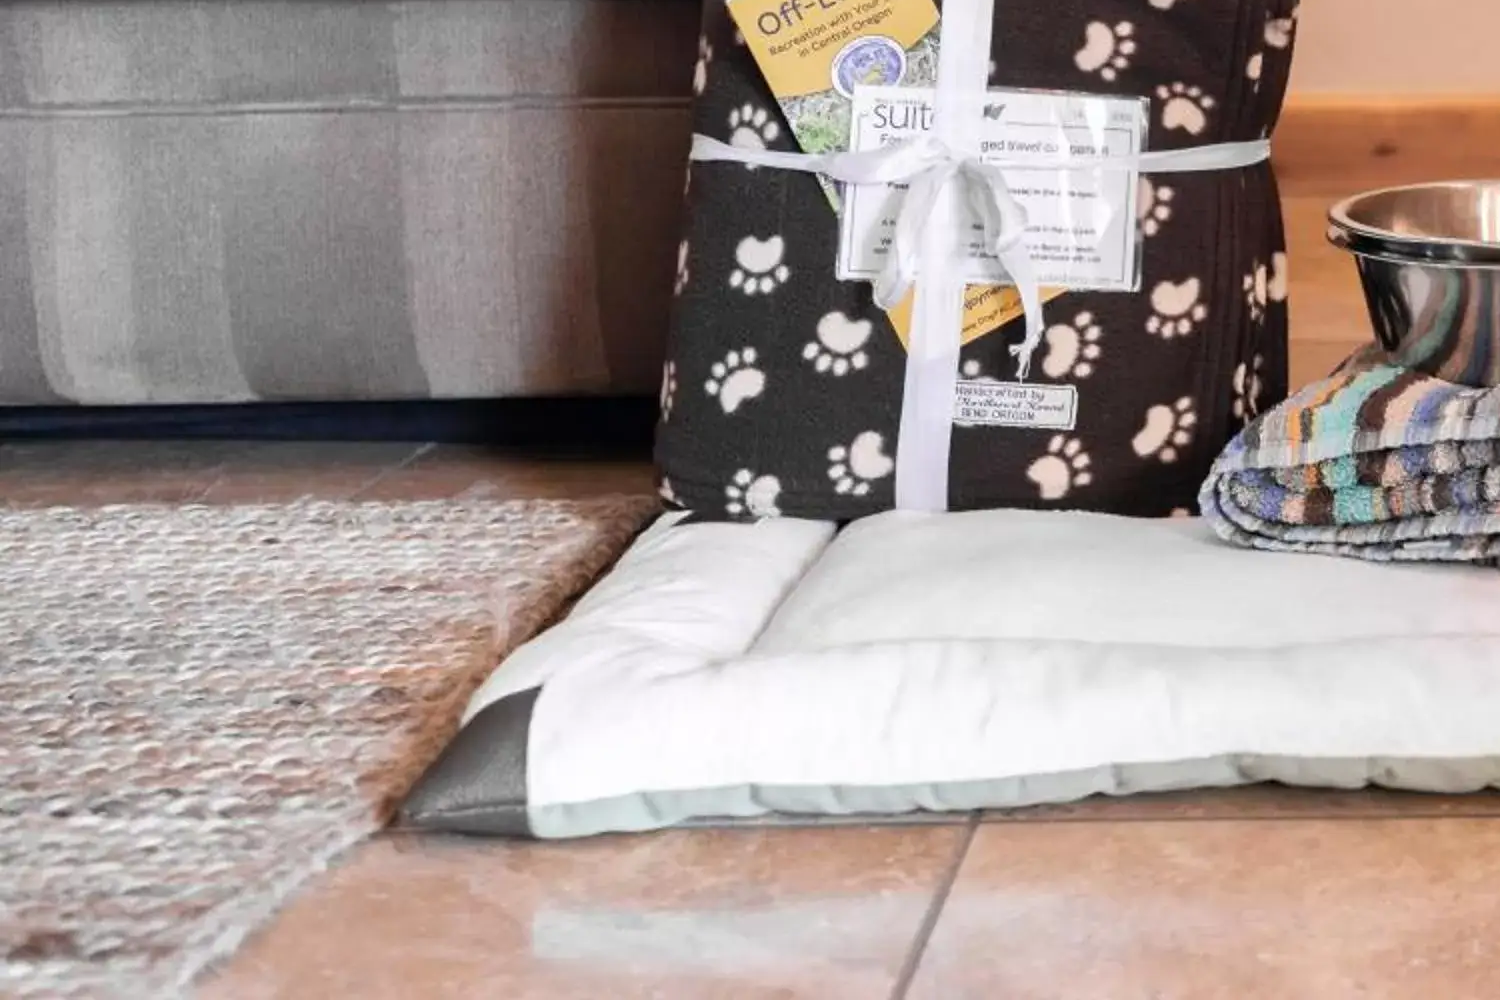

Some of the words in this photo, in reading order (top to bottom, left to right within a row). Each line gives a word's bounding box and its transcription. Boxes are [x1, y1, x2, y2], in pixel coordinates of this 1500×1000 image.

[767, 24, 828, 56] Recreation
[829, 8, 854, 28] with
[798, 46, 810, 58] in
[811, 28, 850, 52] Central
[852, 8, 894, 32] Oregon
[955, 386, 1027, 399] Handcrafted
[1031, 389, 1045, 402] by
